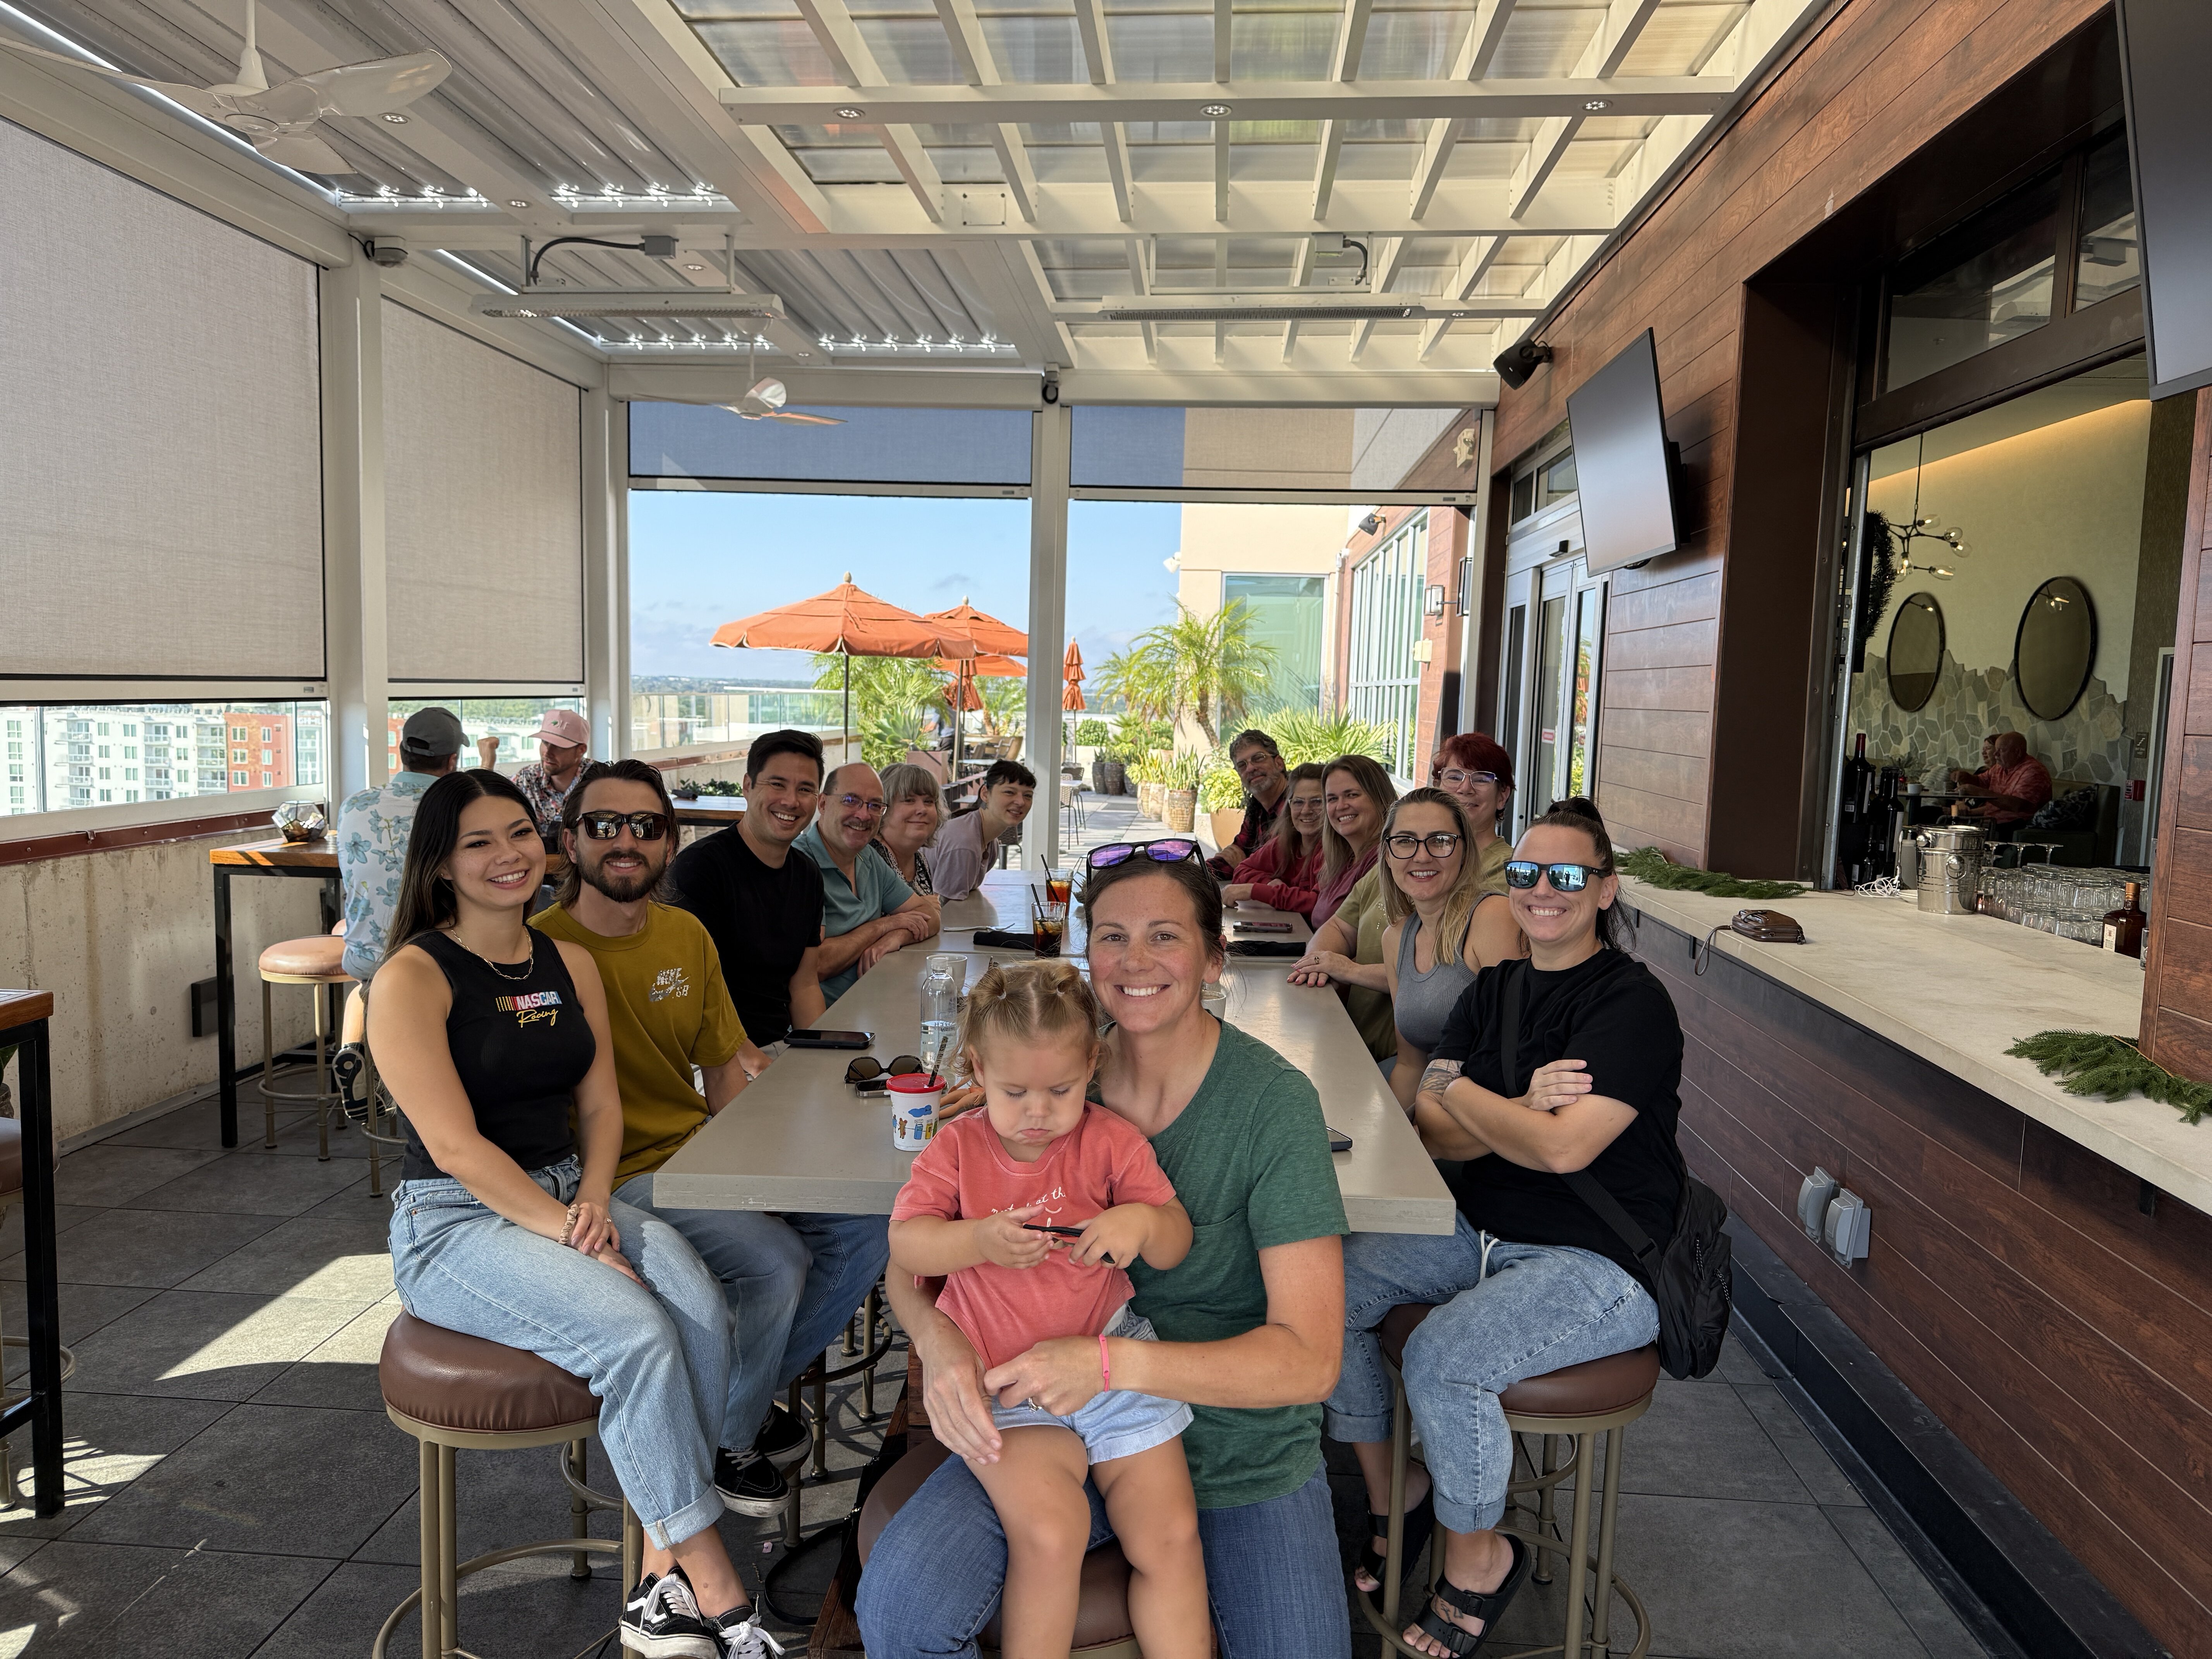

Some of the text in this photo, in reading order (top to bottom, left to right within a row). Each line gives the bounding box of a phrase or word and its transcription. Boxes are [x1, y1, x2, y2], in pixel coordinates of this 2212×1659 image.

[516, 991, 559, 1010] NASCAR
[516, 1008, 559, 1028] Racing
[1036, 1194, 1049, 1205] at
[1051, 1186, 1066, 1200] th
